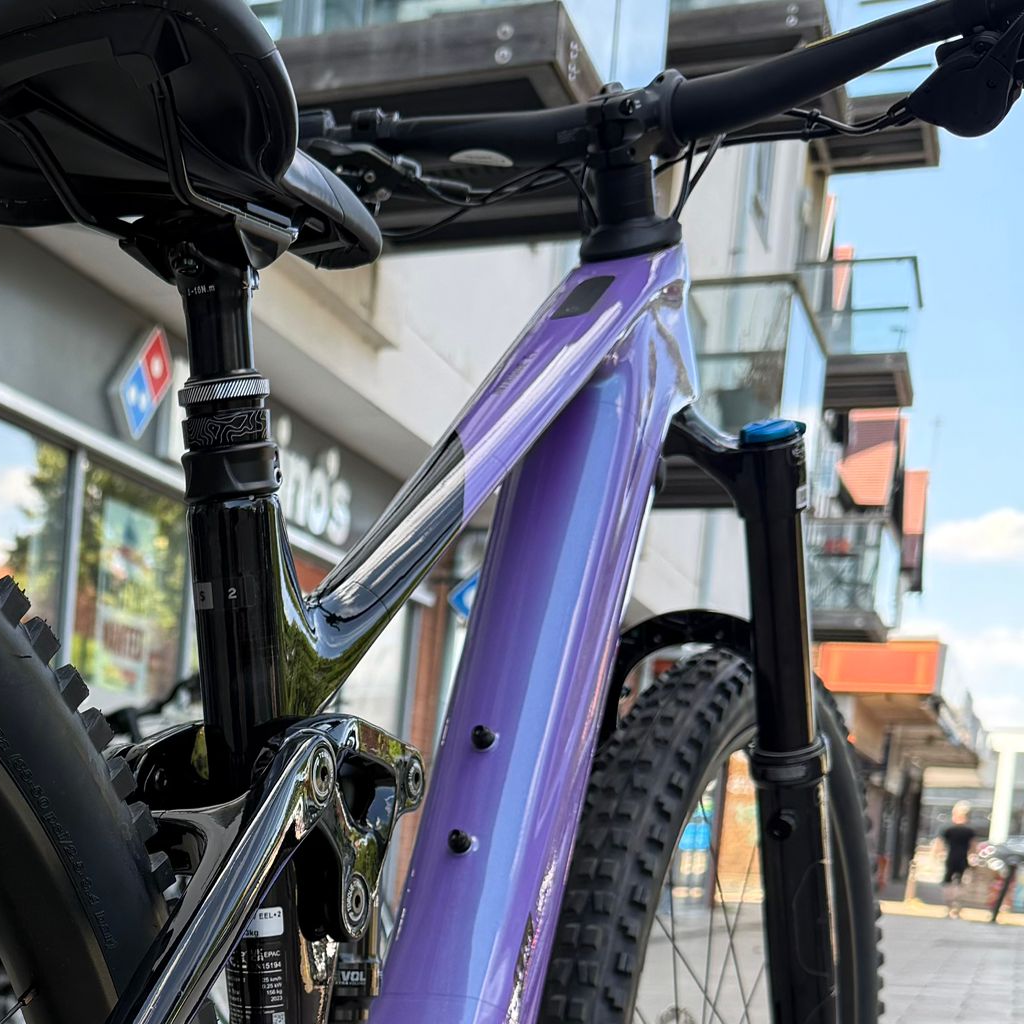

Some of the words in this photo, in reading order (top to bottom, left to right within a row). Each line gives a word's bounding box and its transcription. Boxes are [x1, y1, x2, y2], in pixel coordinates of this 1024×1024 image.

[276, 414, 352, 546] ino's
[228, 587, 237, 600] 2
[264, 950, 281, 958] EPAC
[340, 970, 366, 982] VOL
